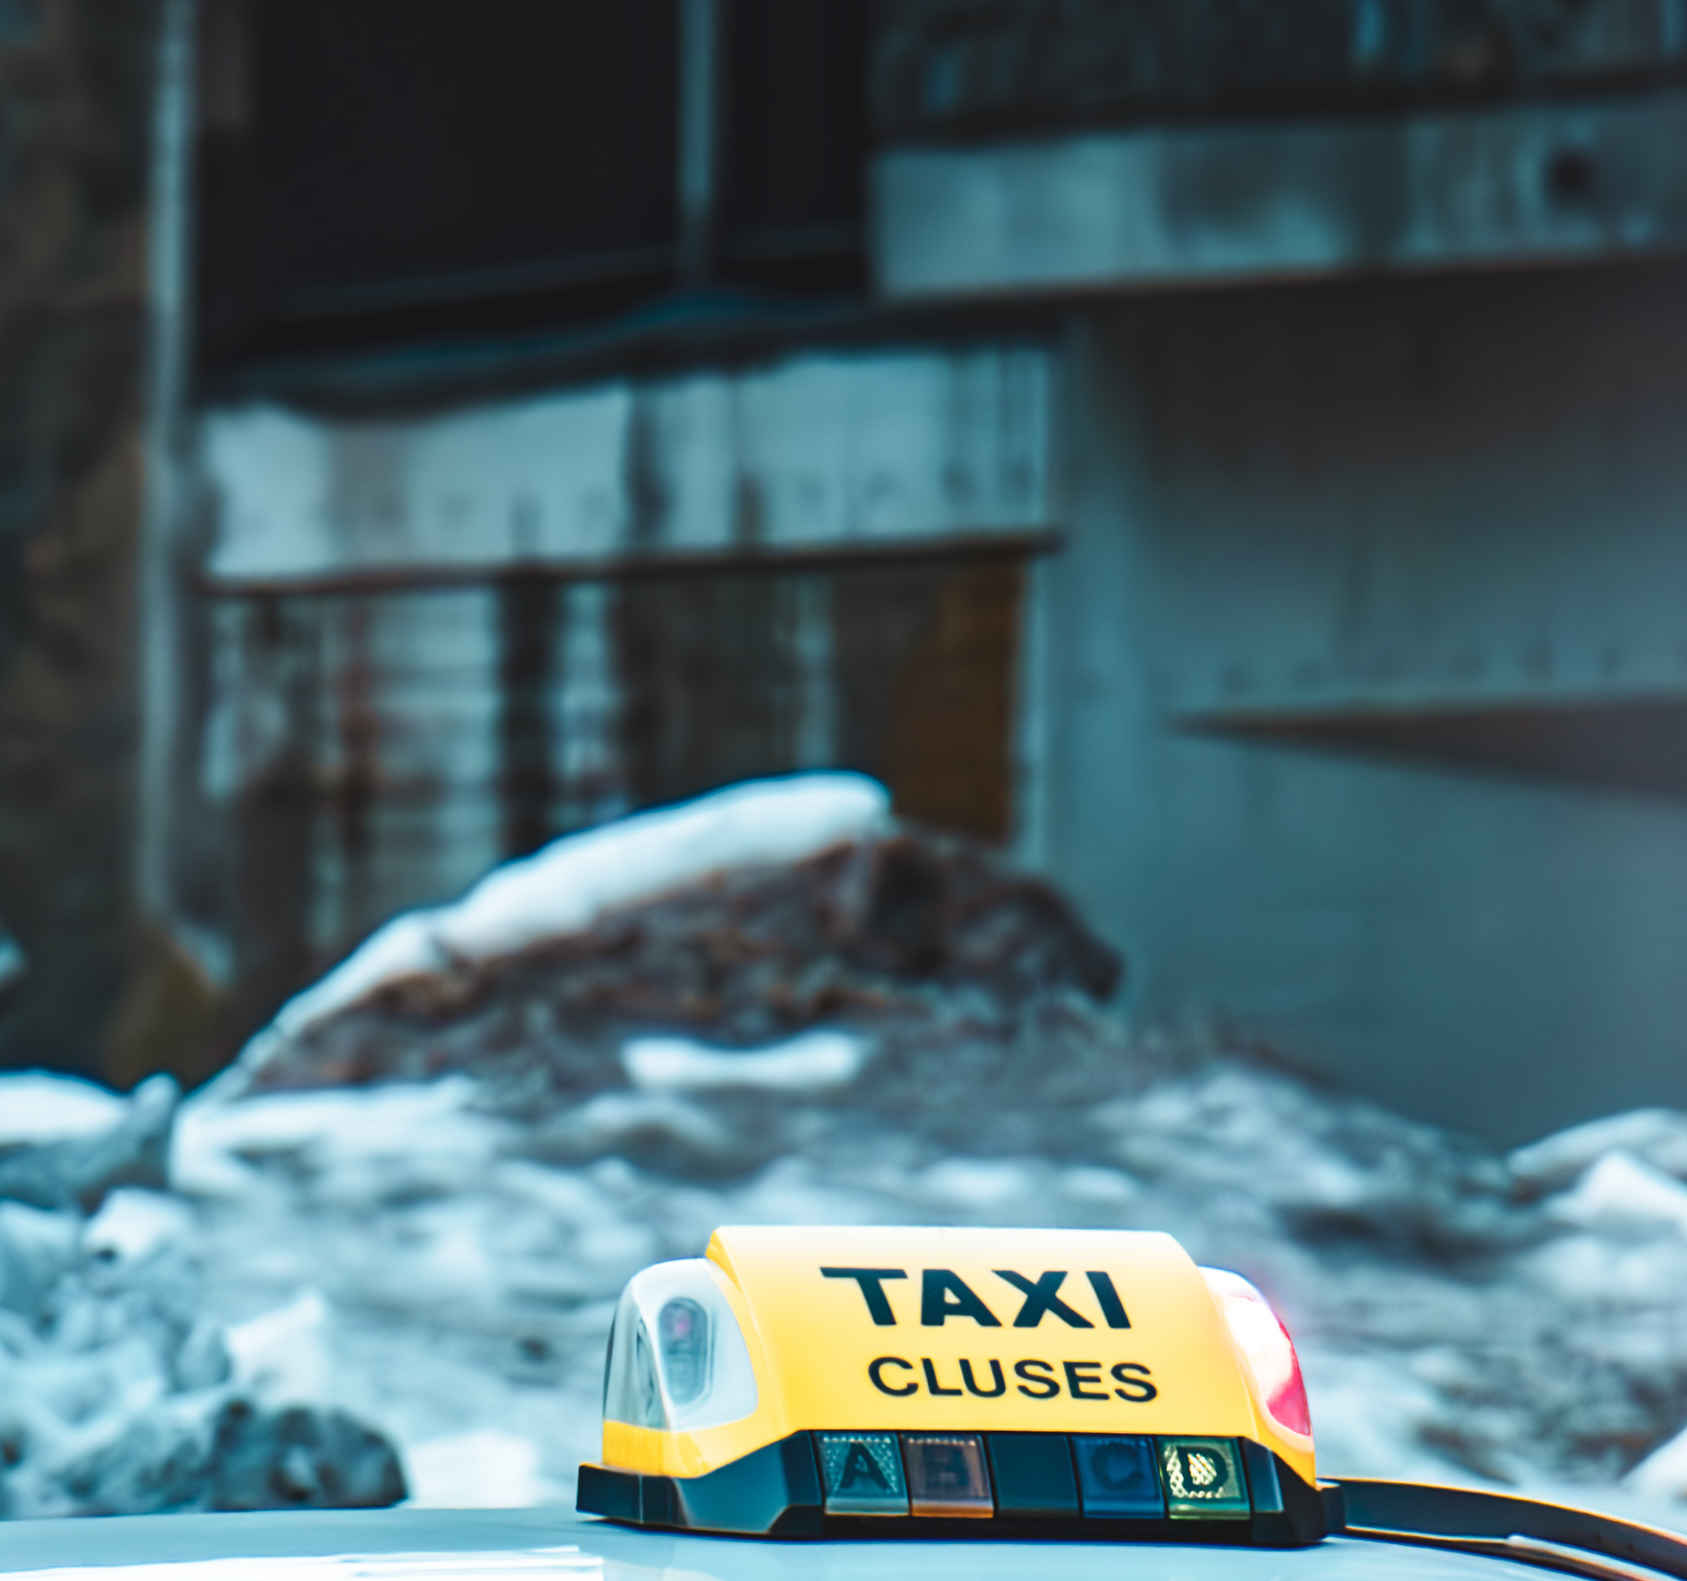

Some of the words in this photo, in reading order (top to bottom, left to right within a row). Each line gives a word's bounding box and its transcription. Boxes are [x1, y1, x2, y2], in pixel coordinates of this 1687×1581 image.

[820, 1267, 1131, 1330] TAXI
[867, 1356, 1158, 1402] CLUSES
[839, 1442, 891, 1489] A
[922, 1445, 969, 1489] B
[1090, 1443, 1144, 1489] C
[1176, 1445, 1228, 1493] D
